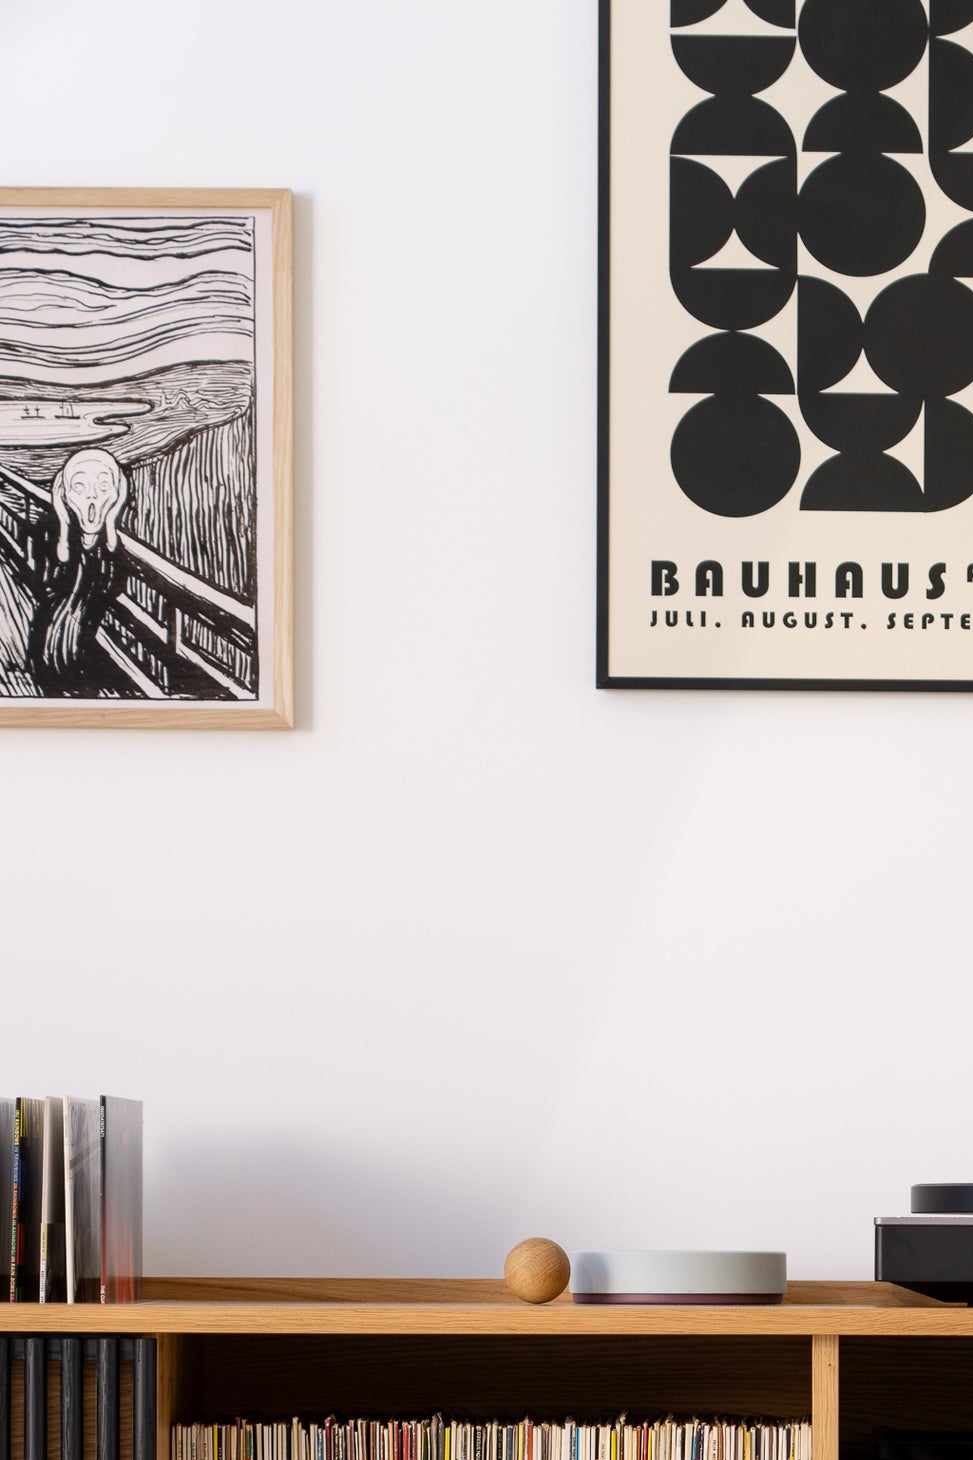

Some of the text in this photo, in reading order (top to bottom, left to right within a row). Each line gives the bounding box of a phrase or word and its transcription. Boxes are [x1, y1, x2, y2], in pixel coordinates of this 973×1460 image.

[651, 560, 947, 601] BAUHAUS
[650, 610, 721, 629] JULI.
[741, 611, 868, 630] AUGUST.
